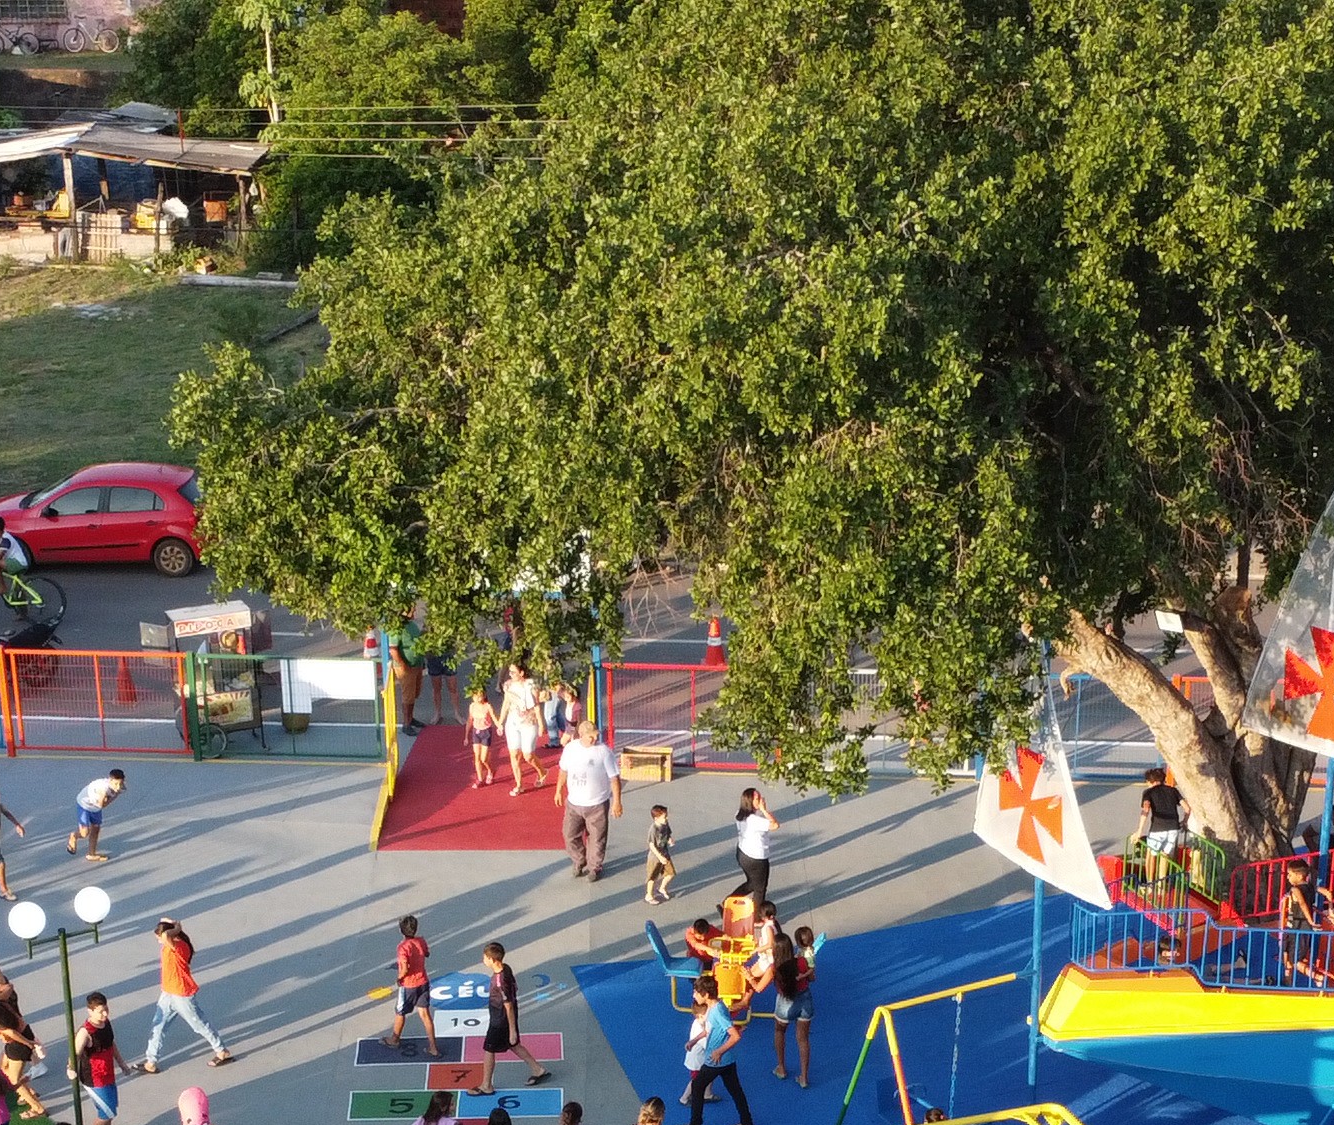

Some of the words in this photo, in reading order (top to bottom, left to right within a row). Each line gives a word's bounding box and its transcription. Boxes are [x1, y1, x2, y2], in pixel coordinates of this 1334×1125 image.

[178, 618, 234, 633] PIPOCA
[450, 1017, 481, 1027] 10
[450, 1069, 472, 1083] 7
[388, 1098, 414, 1114] 5
[497, 1095, 520, 1110] 6
